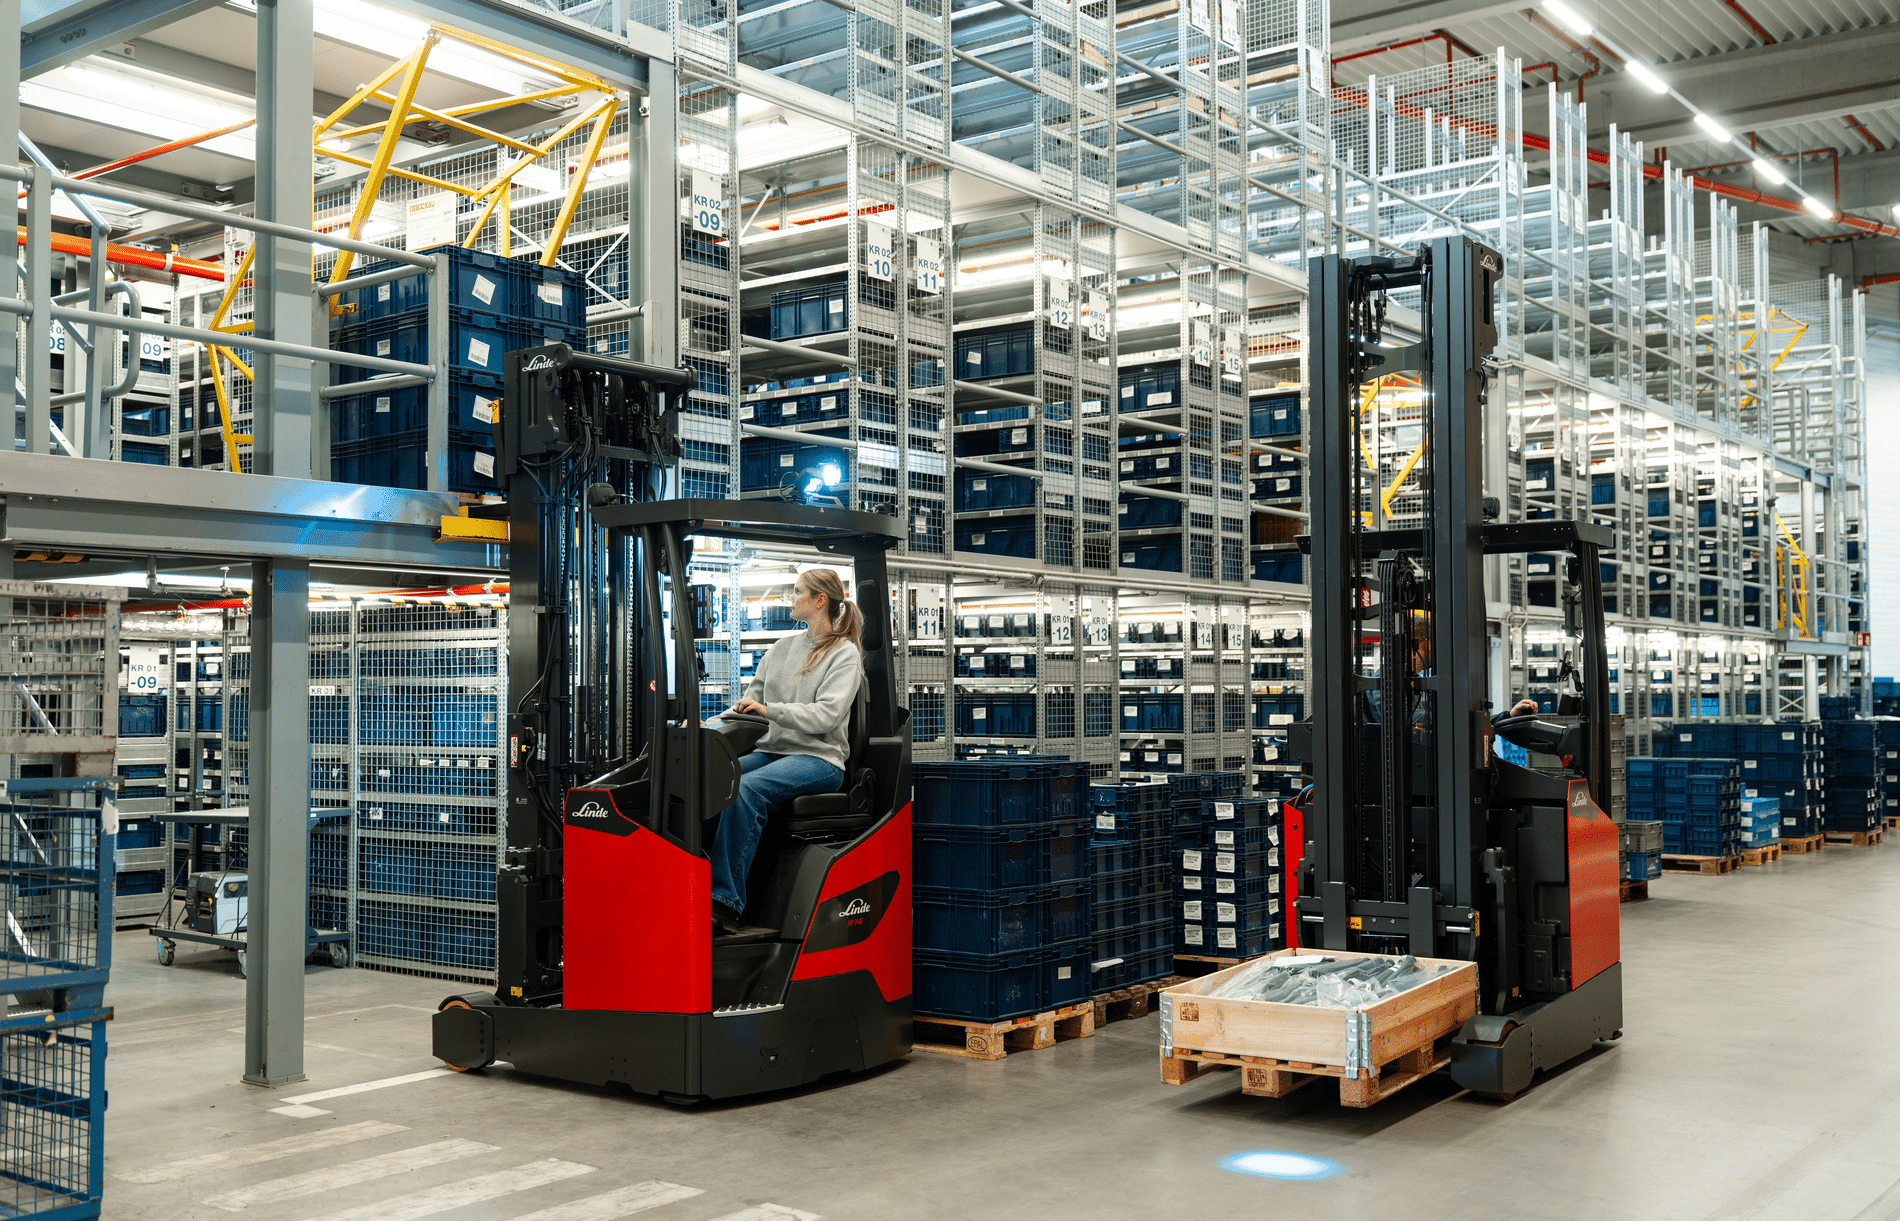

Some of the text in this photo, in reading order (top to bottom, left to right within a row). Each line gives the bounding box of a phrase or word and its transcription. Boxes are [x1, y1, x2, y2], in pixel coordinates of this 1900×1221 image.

[694, 194, 721, 210] KR 02
[694, 210, 720, 231] -09
[868, 244, 891, 258] KR 02
[869, 259, 890, 277] -10
[918, 258, 938, 272] KR 02
[918, 272, 936, 290] -11
[1052, 296, 1068, 309] KR 02
[1052, 310, 1068, 326] -12
[1090, 310, 1106, 322] KR 02
[1090, 322, 1106, 338] -13
[522, 354, 555, 372] Linde
[1196, 350, 1208, 363] -14
[1226, 358, 1239, 370] -15
[918, 608, 938, 616] KR 01
[1052, 616, 1070, 624] KR 01
[1092, 616, 1100, 625] KR
[918, 620, 936, 636] -11
[1052, 626, 1070, 640] -12
[1092, 628, 1108, 642] -13
[1198, 632, 1211, 646] -14
[1228, 634, 1242, 646] -15
[130, 676, 156, 688] -09
[572, 801, 608, 818] Linde
[838, 898, 870, 918] Linde
